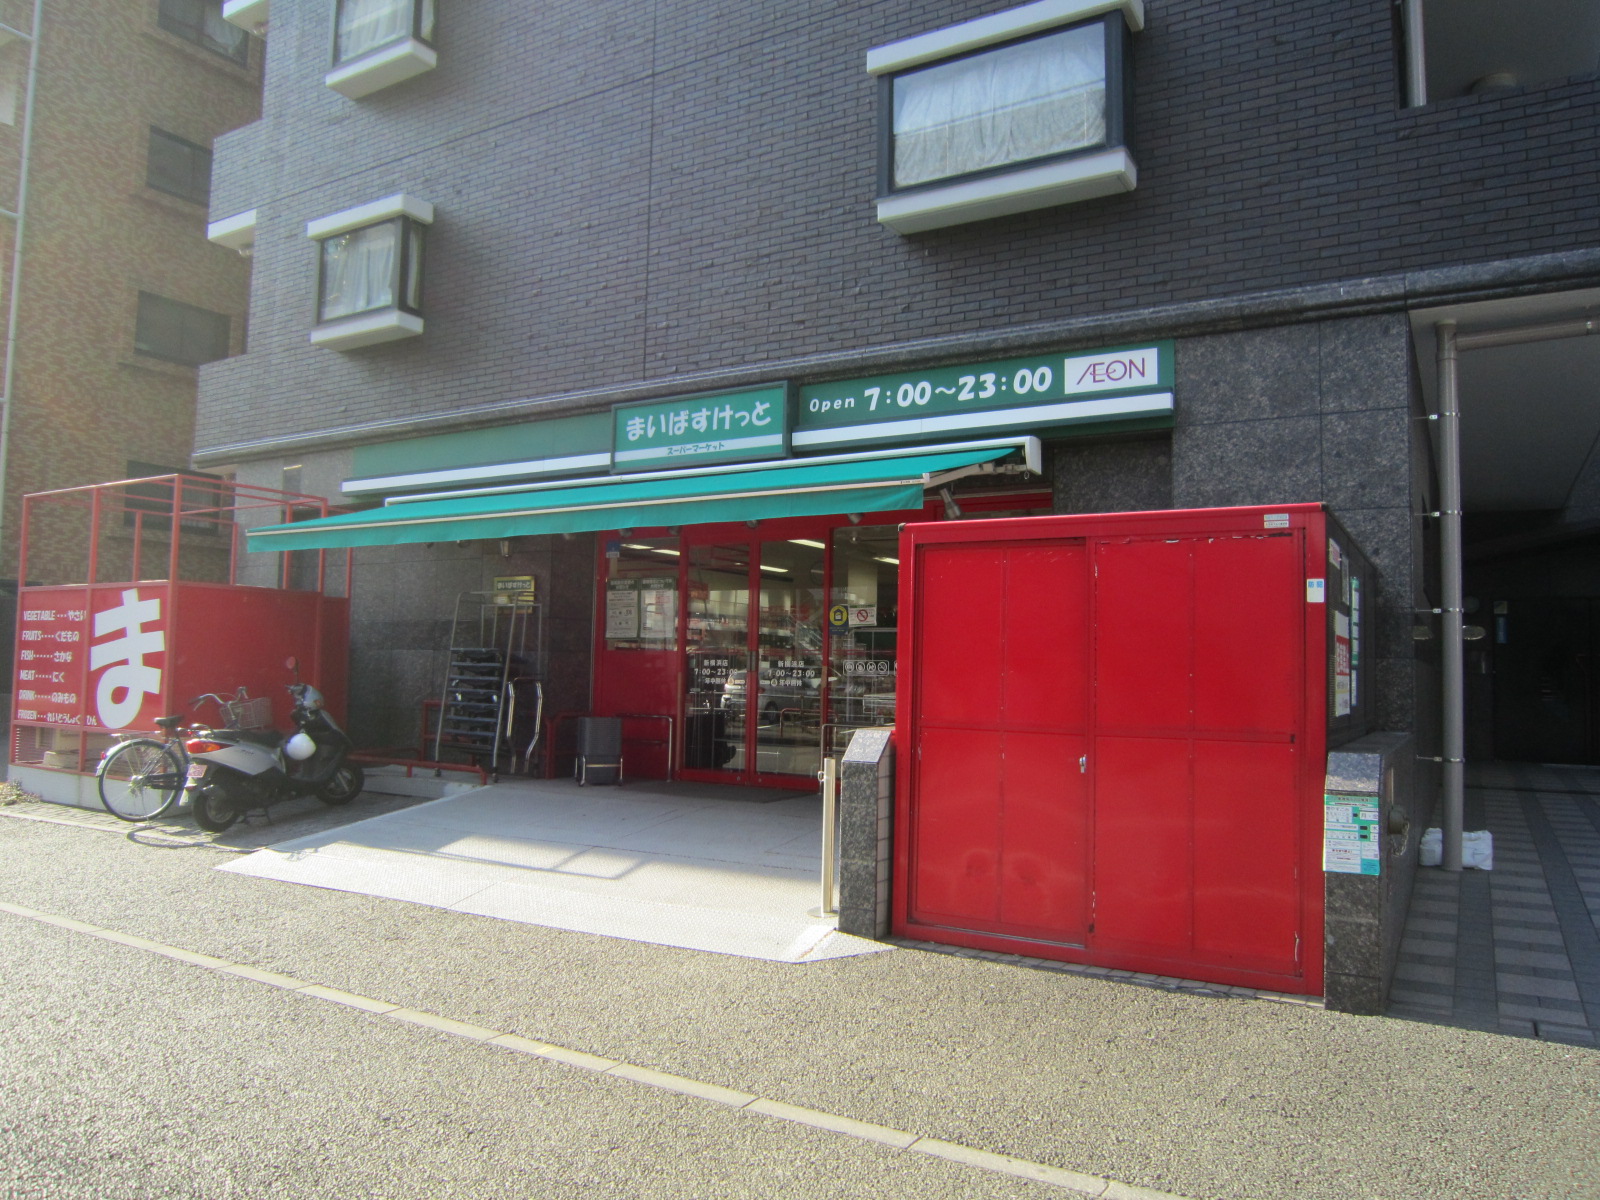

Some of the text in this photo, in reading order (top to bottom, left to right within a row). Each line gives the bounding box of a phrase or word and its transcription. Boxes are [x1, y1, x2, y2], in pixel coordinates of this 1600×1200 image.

[809, 396, 856, 414] Open
[626, 401, 771, 442] まいばすけっと
[667, 442, 725, 456] スーパーマーケット
[24, 610, 56, 621] VEGETABLE
[22, 630, 80, 642] FRUITS くだもの
[20, 650, 73, 663] FISH さかな
[89, 588, 165, 729] ま
[703, 659, 728, 667] 新横浜店
[19, 670, 65, 683] MEAT にく
[51, 692, 77, 704] のみもの
[17, 709, 37, 721] FROZEN
